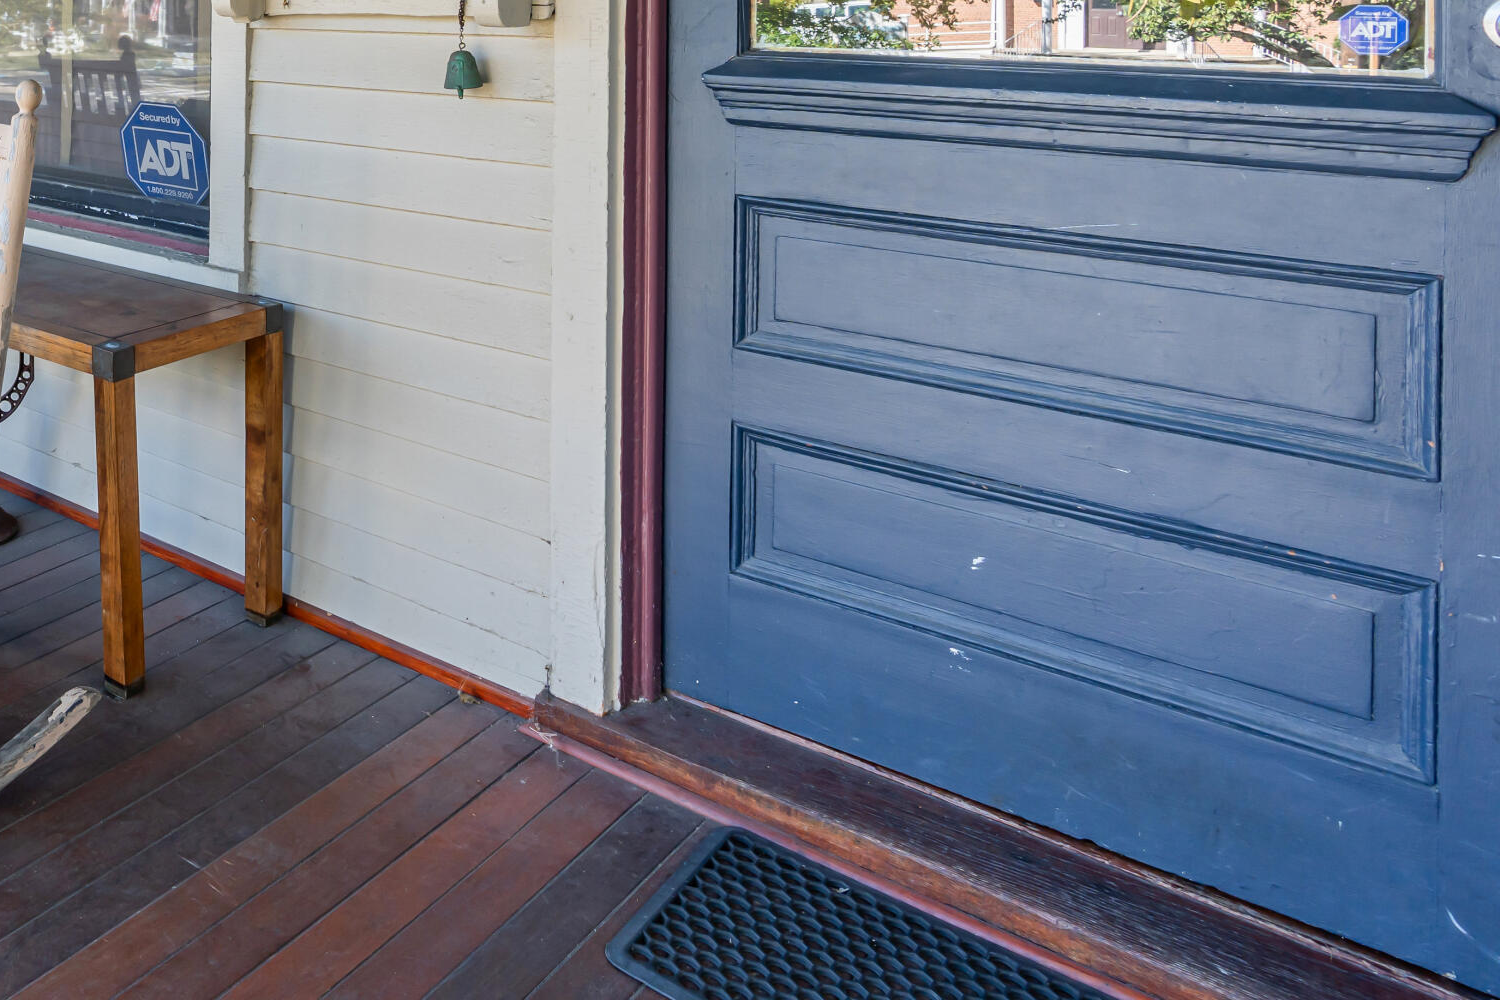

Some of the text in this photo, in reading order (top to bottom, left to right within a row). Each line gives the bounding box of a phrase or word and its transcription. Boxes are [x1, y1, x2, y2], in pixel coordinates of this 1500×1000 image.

[1350, 21, 1397, 39] ADT
[139, 111, 181, 127] Secured by
[140, 138, 192, 180] ADT
